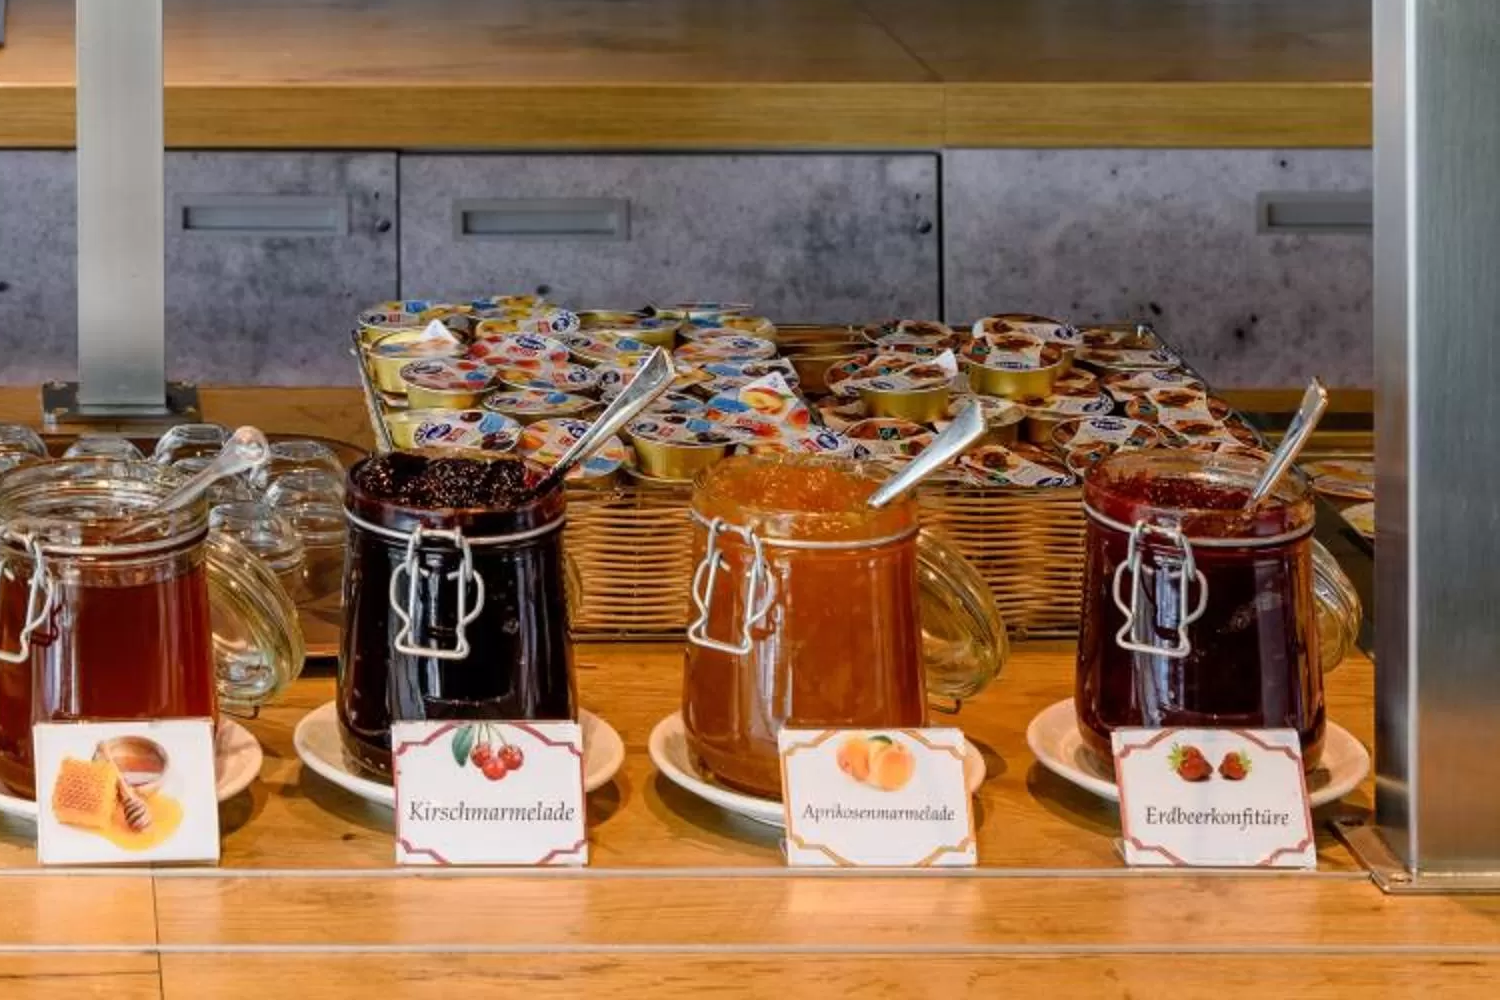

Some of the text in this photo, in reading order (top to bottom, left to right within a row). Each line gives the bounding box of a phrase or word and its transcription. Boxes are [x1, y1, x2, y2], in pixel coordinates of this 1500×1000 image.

[408, 800, 575, 822] Kirschmarmelade
[802, 802, 956, 823] Aprikosenmarmelade
[1145, 806, 1290, 831] Erdbeerkonfitüre
